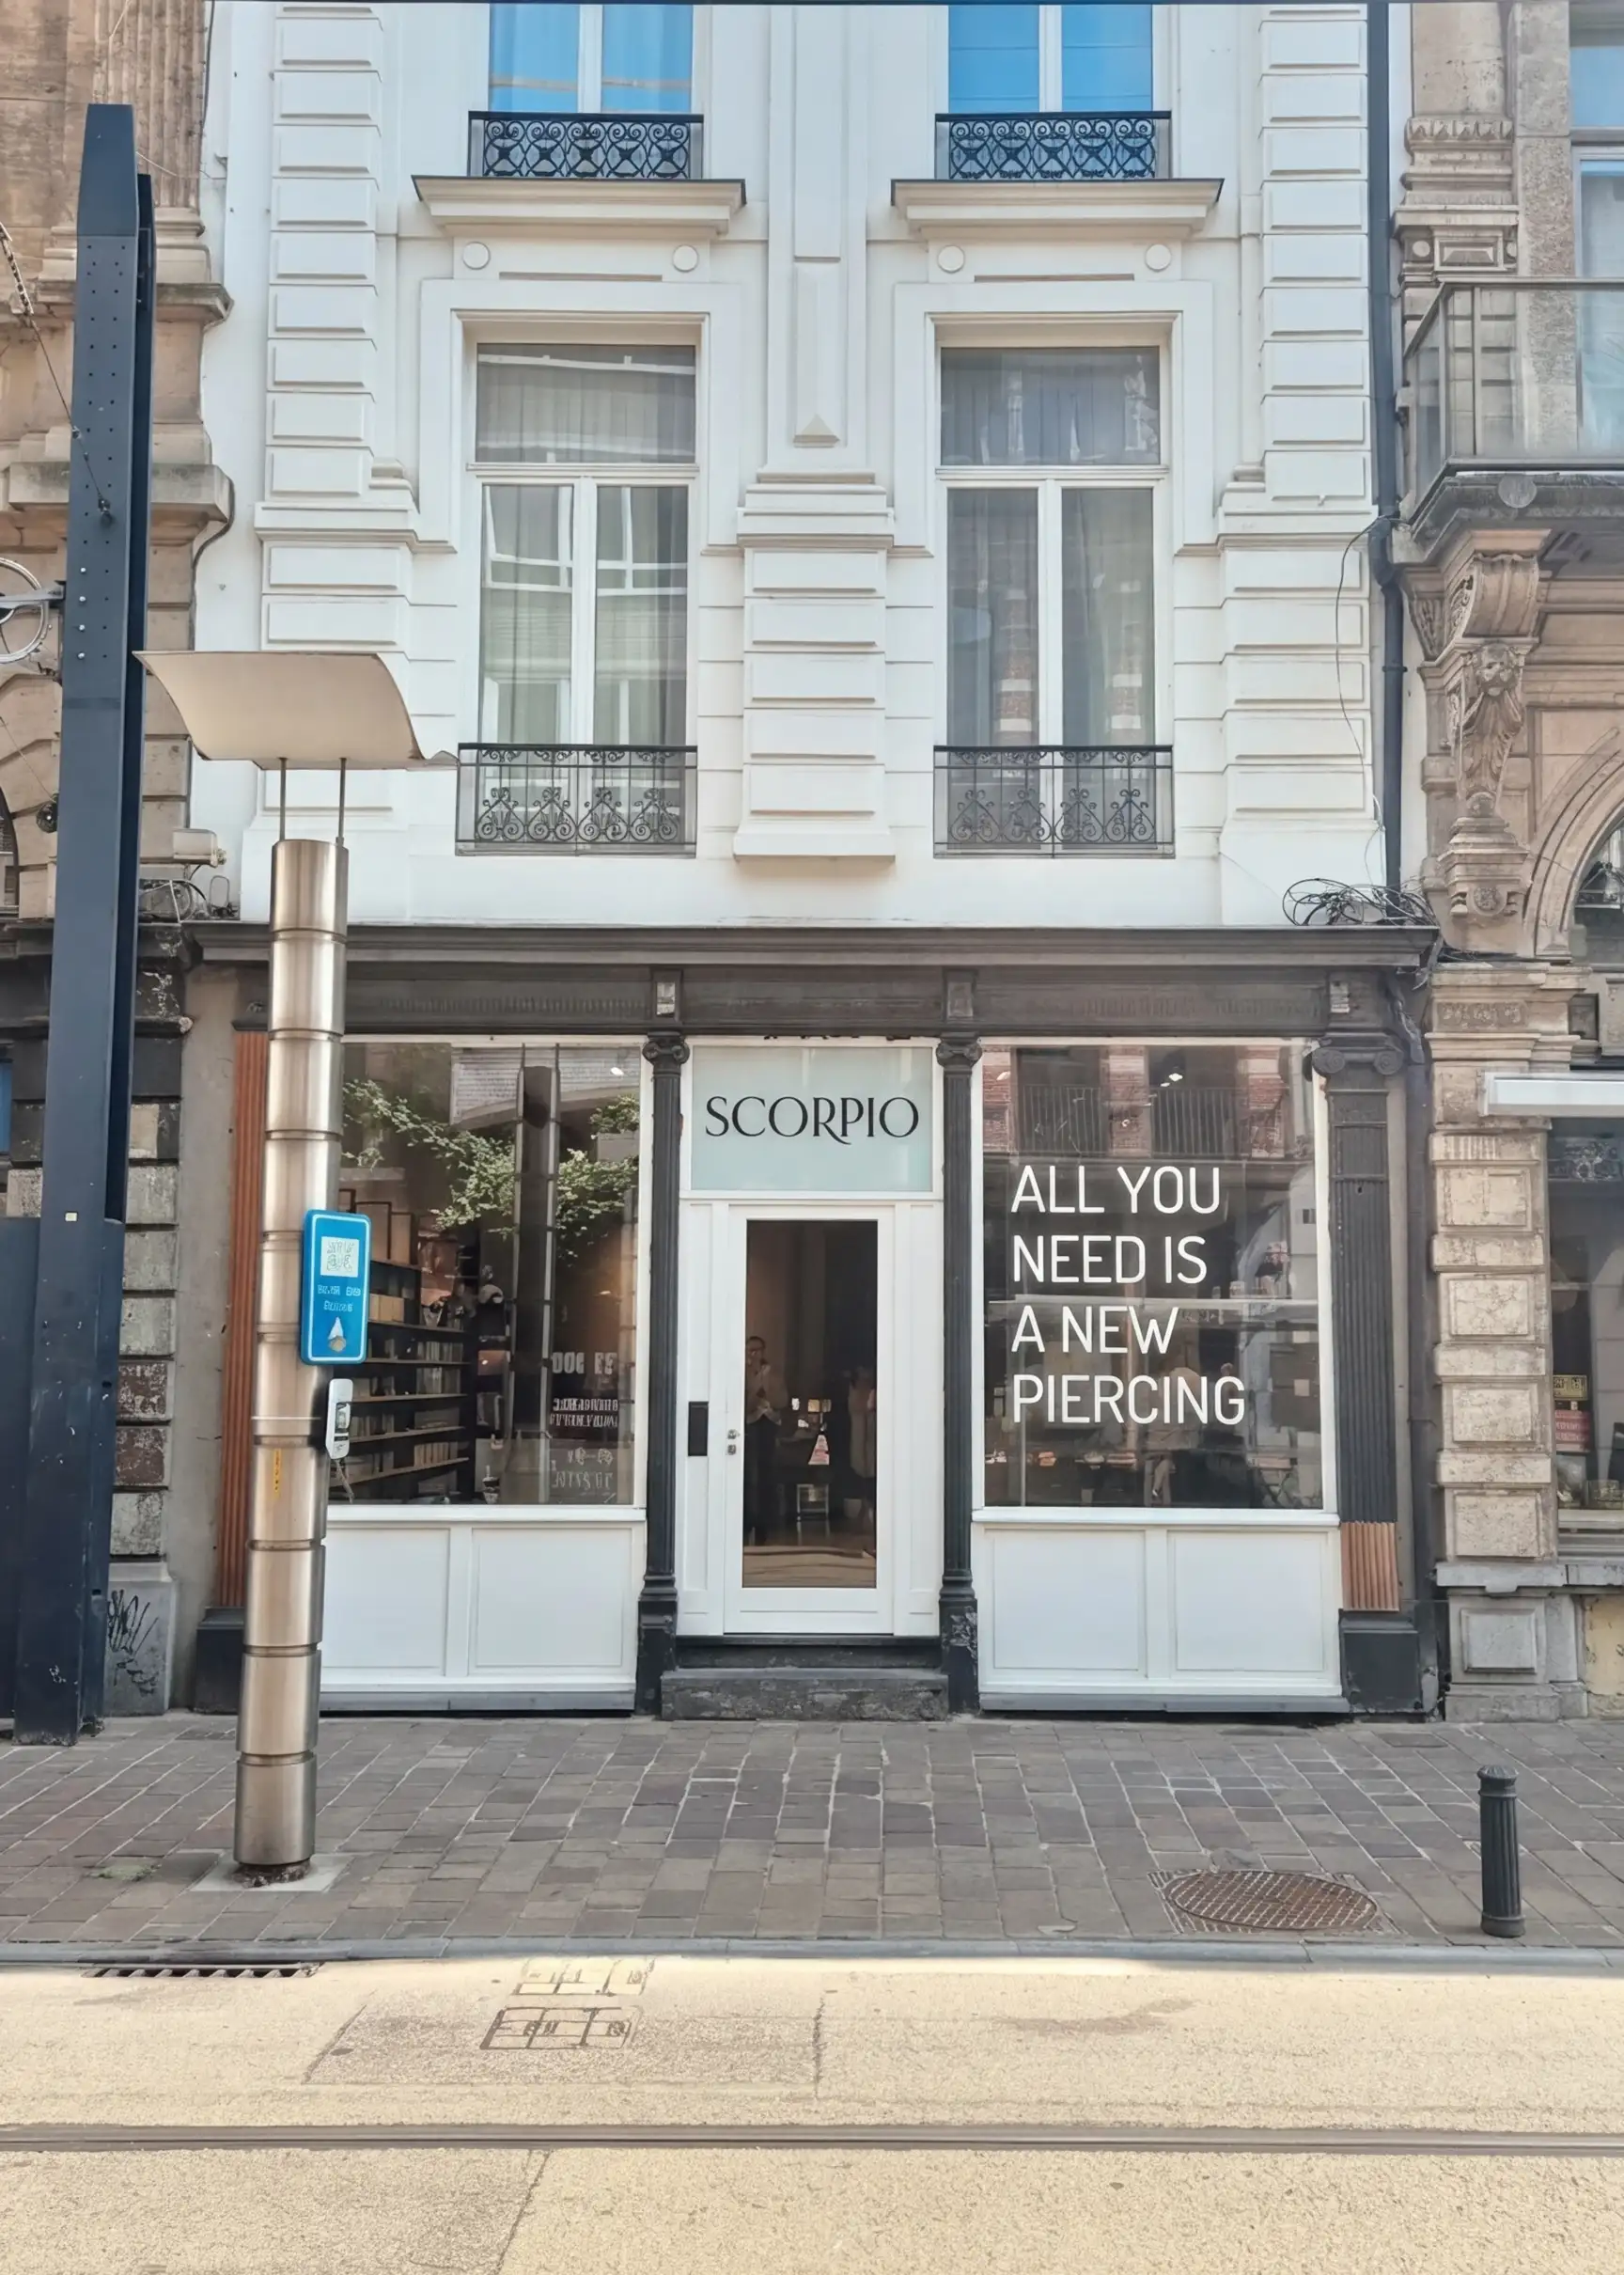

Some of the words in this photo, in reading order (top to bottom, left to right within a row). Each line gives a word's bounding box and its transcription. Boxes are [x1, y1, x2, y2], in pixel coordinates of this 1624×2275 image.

[706, 1096, 919, 1145] SCORPIO
[1010, 1165, 1105, 1214] ALL
[1116, 1166, 1220, 1214] YOU
[1013, 1234, 1146, 1283] NEED
[1164, 1235, 1207, 1284] IS
[1011, 1305, 1045, 1353] A
[1062, 1306, 1179, 1355] NEW
[1013, 1373, 1245, 1425] PIERCING
